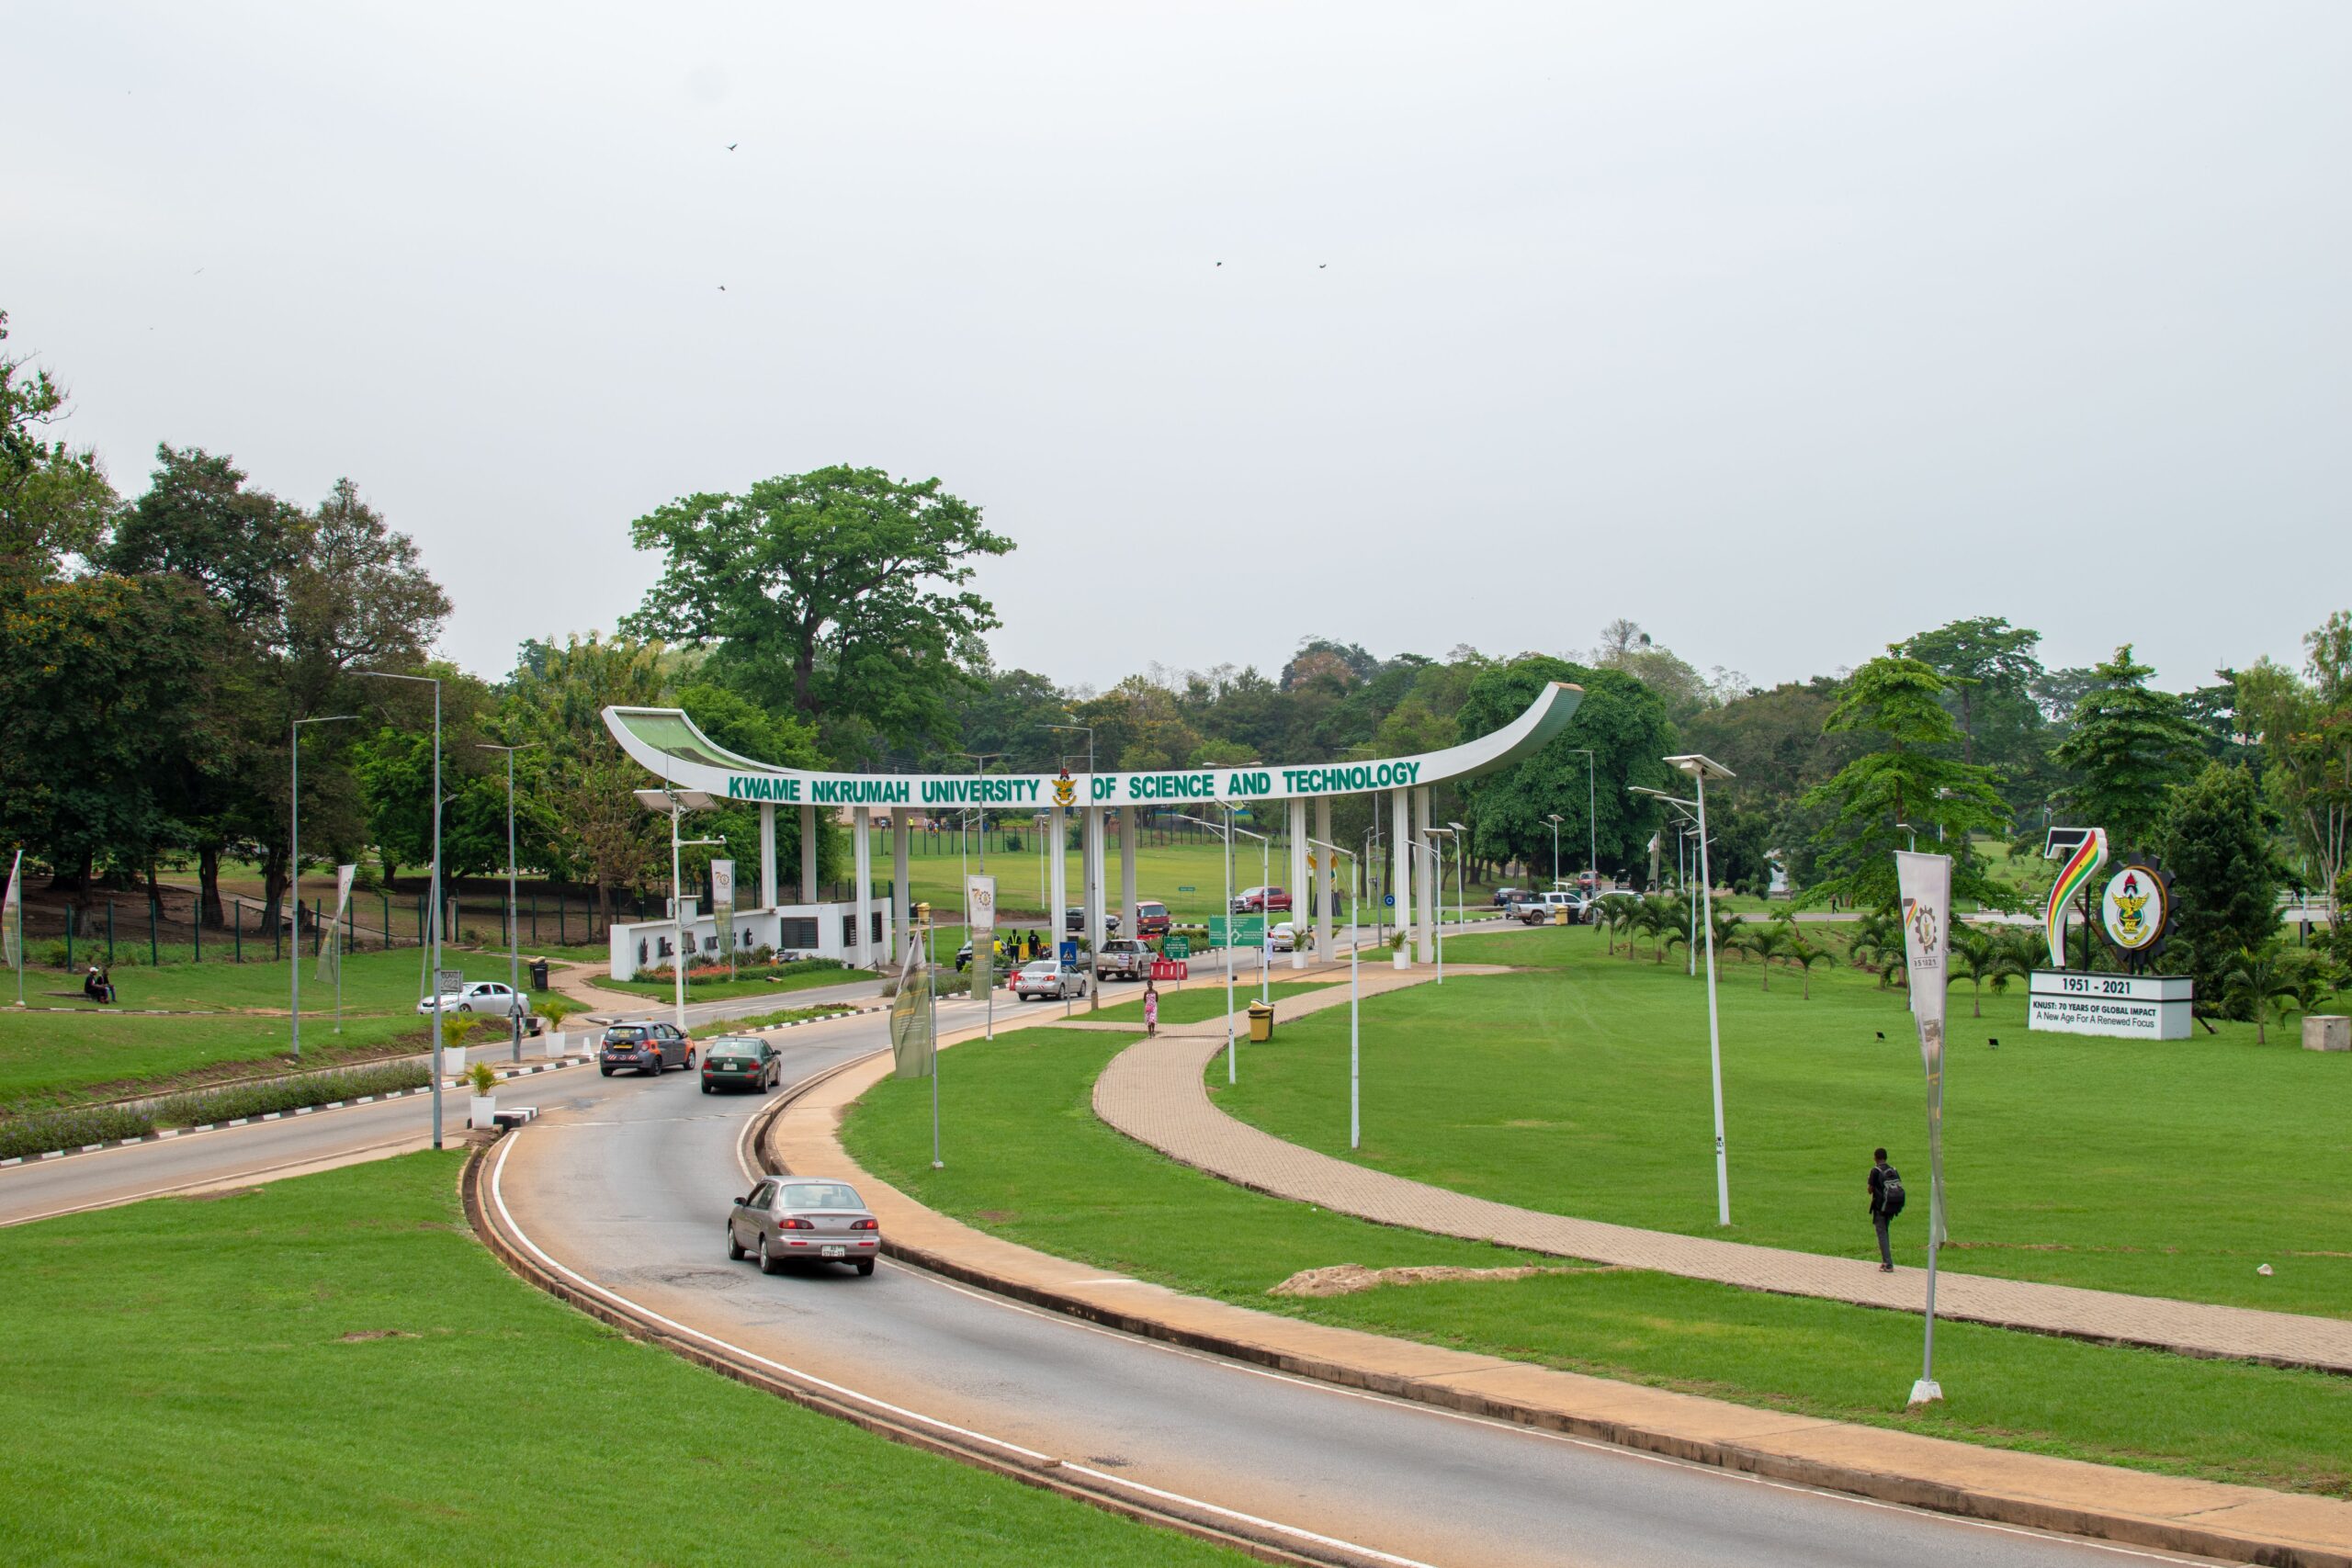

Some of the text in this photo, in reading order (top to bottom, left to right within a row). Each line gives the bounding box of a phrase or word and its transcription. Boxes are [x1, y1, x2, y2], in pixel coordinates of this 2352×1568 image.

[729, 761, 1420, 803] KWAME NKRUMAH UNIVERSITY OF SCIENCE AND TECHNOLOGY
[2063, 978, 2088, 991] 1951
[2102, 980, 2131, 994] 2021
[2033, 1001, 2156, 1017] KNUST: 70 YEARS OF GLOBAL IMPACT
[2036, 1011, 2154, 1028] A New Age For A Renewed Focus
